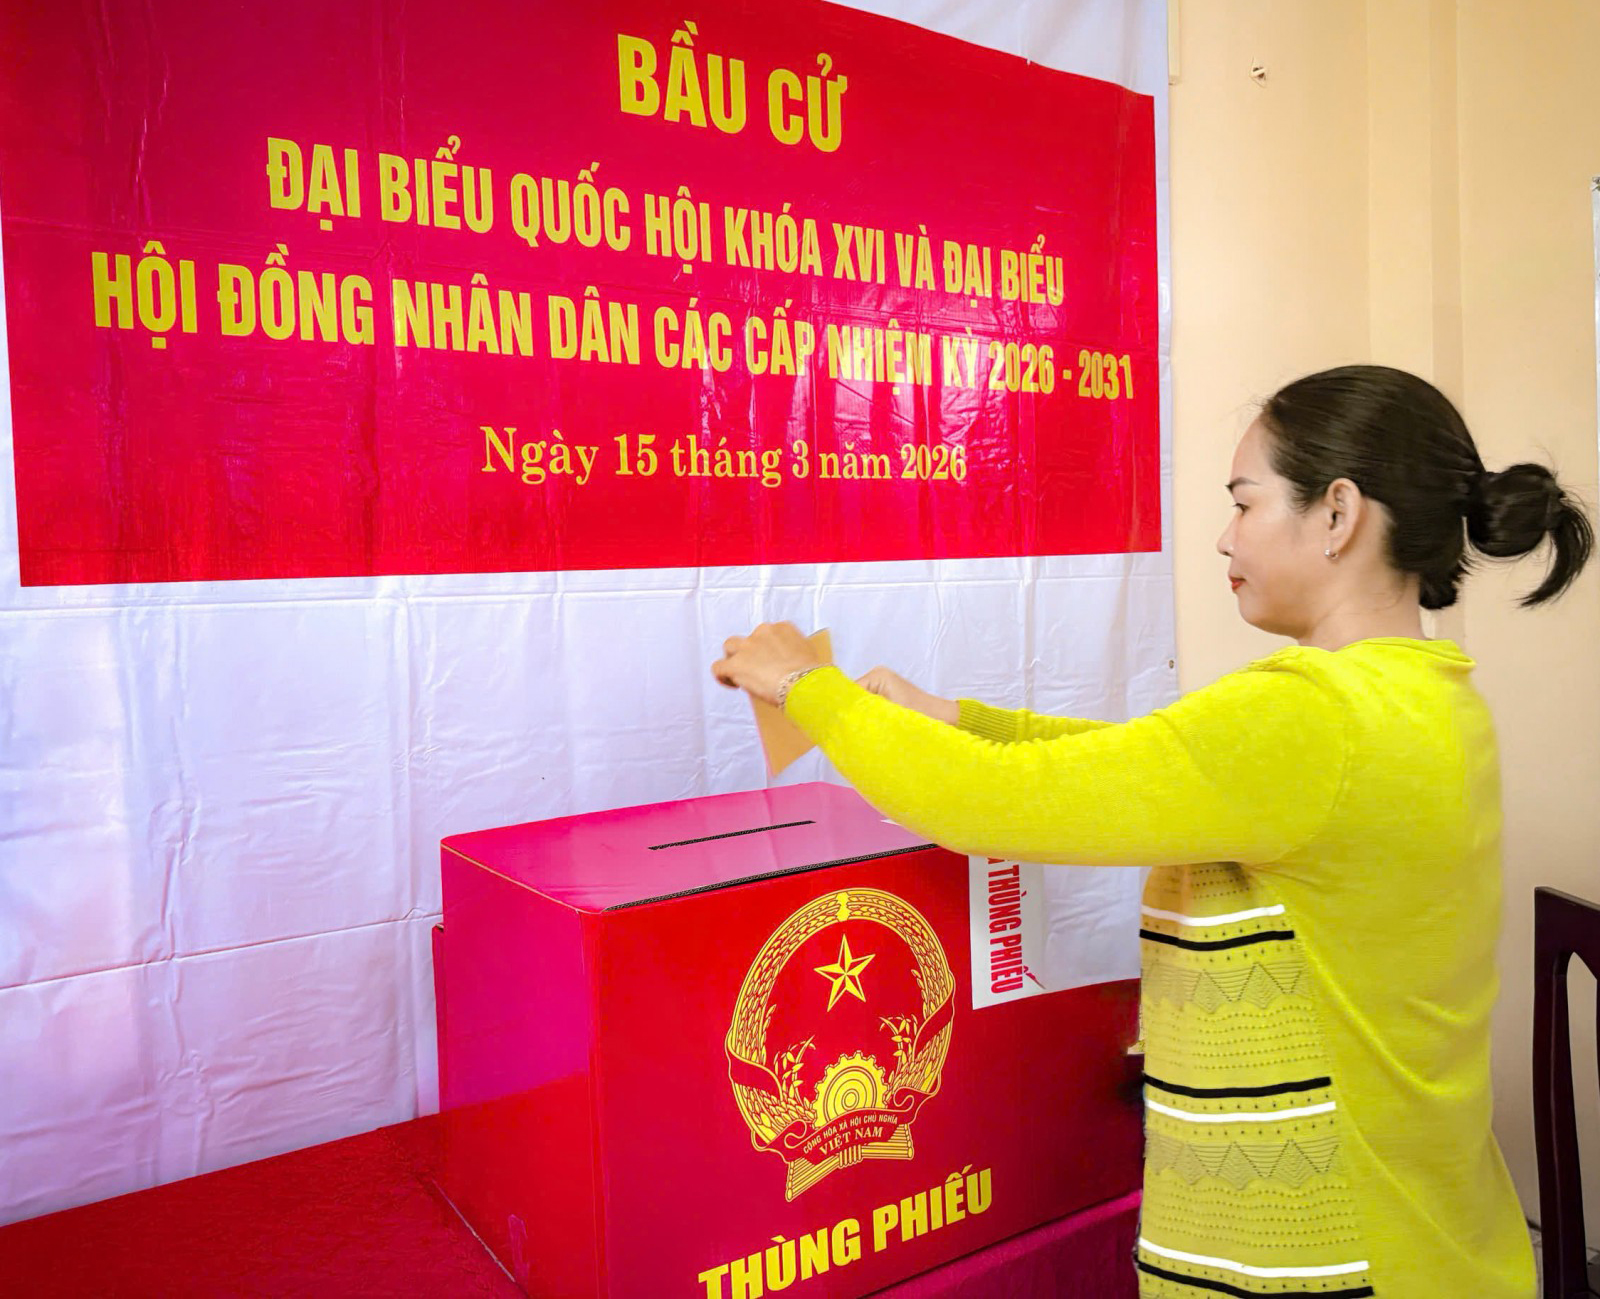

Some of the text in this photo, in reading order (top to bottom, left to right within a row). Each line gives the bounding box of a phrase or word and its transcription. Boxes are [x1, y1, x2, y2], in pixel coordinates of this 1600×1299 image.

[618, 20, 848, 153] BẦU CỬ
[267, 135, 1064, 307] ĐẠI BIỂU QUỐC HỘI KHÓA XVI VÀ ĐẠI BIỂU
[92, 241, 1134, 400] HỘI ĐỒNG NHÂN DÂN CÁC CẤP NHIỆM KỲ 2026 - 2031
[480, 427, 968, 488] Ngày 15 tháng 3 năm 2026
[987, 863, 1028, 934] THÙNG
[989, 932, 1037, 995] PHIẾU
[819, 1126, 884, 1156] VIỆT NAM
[698, 1163, 993, 1299] THÙNG PHIẾU
